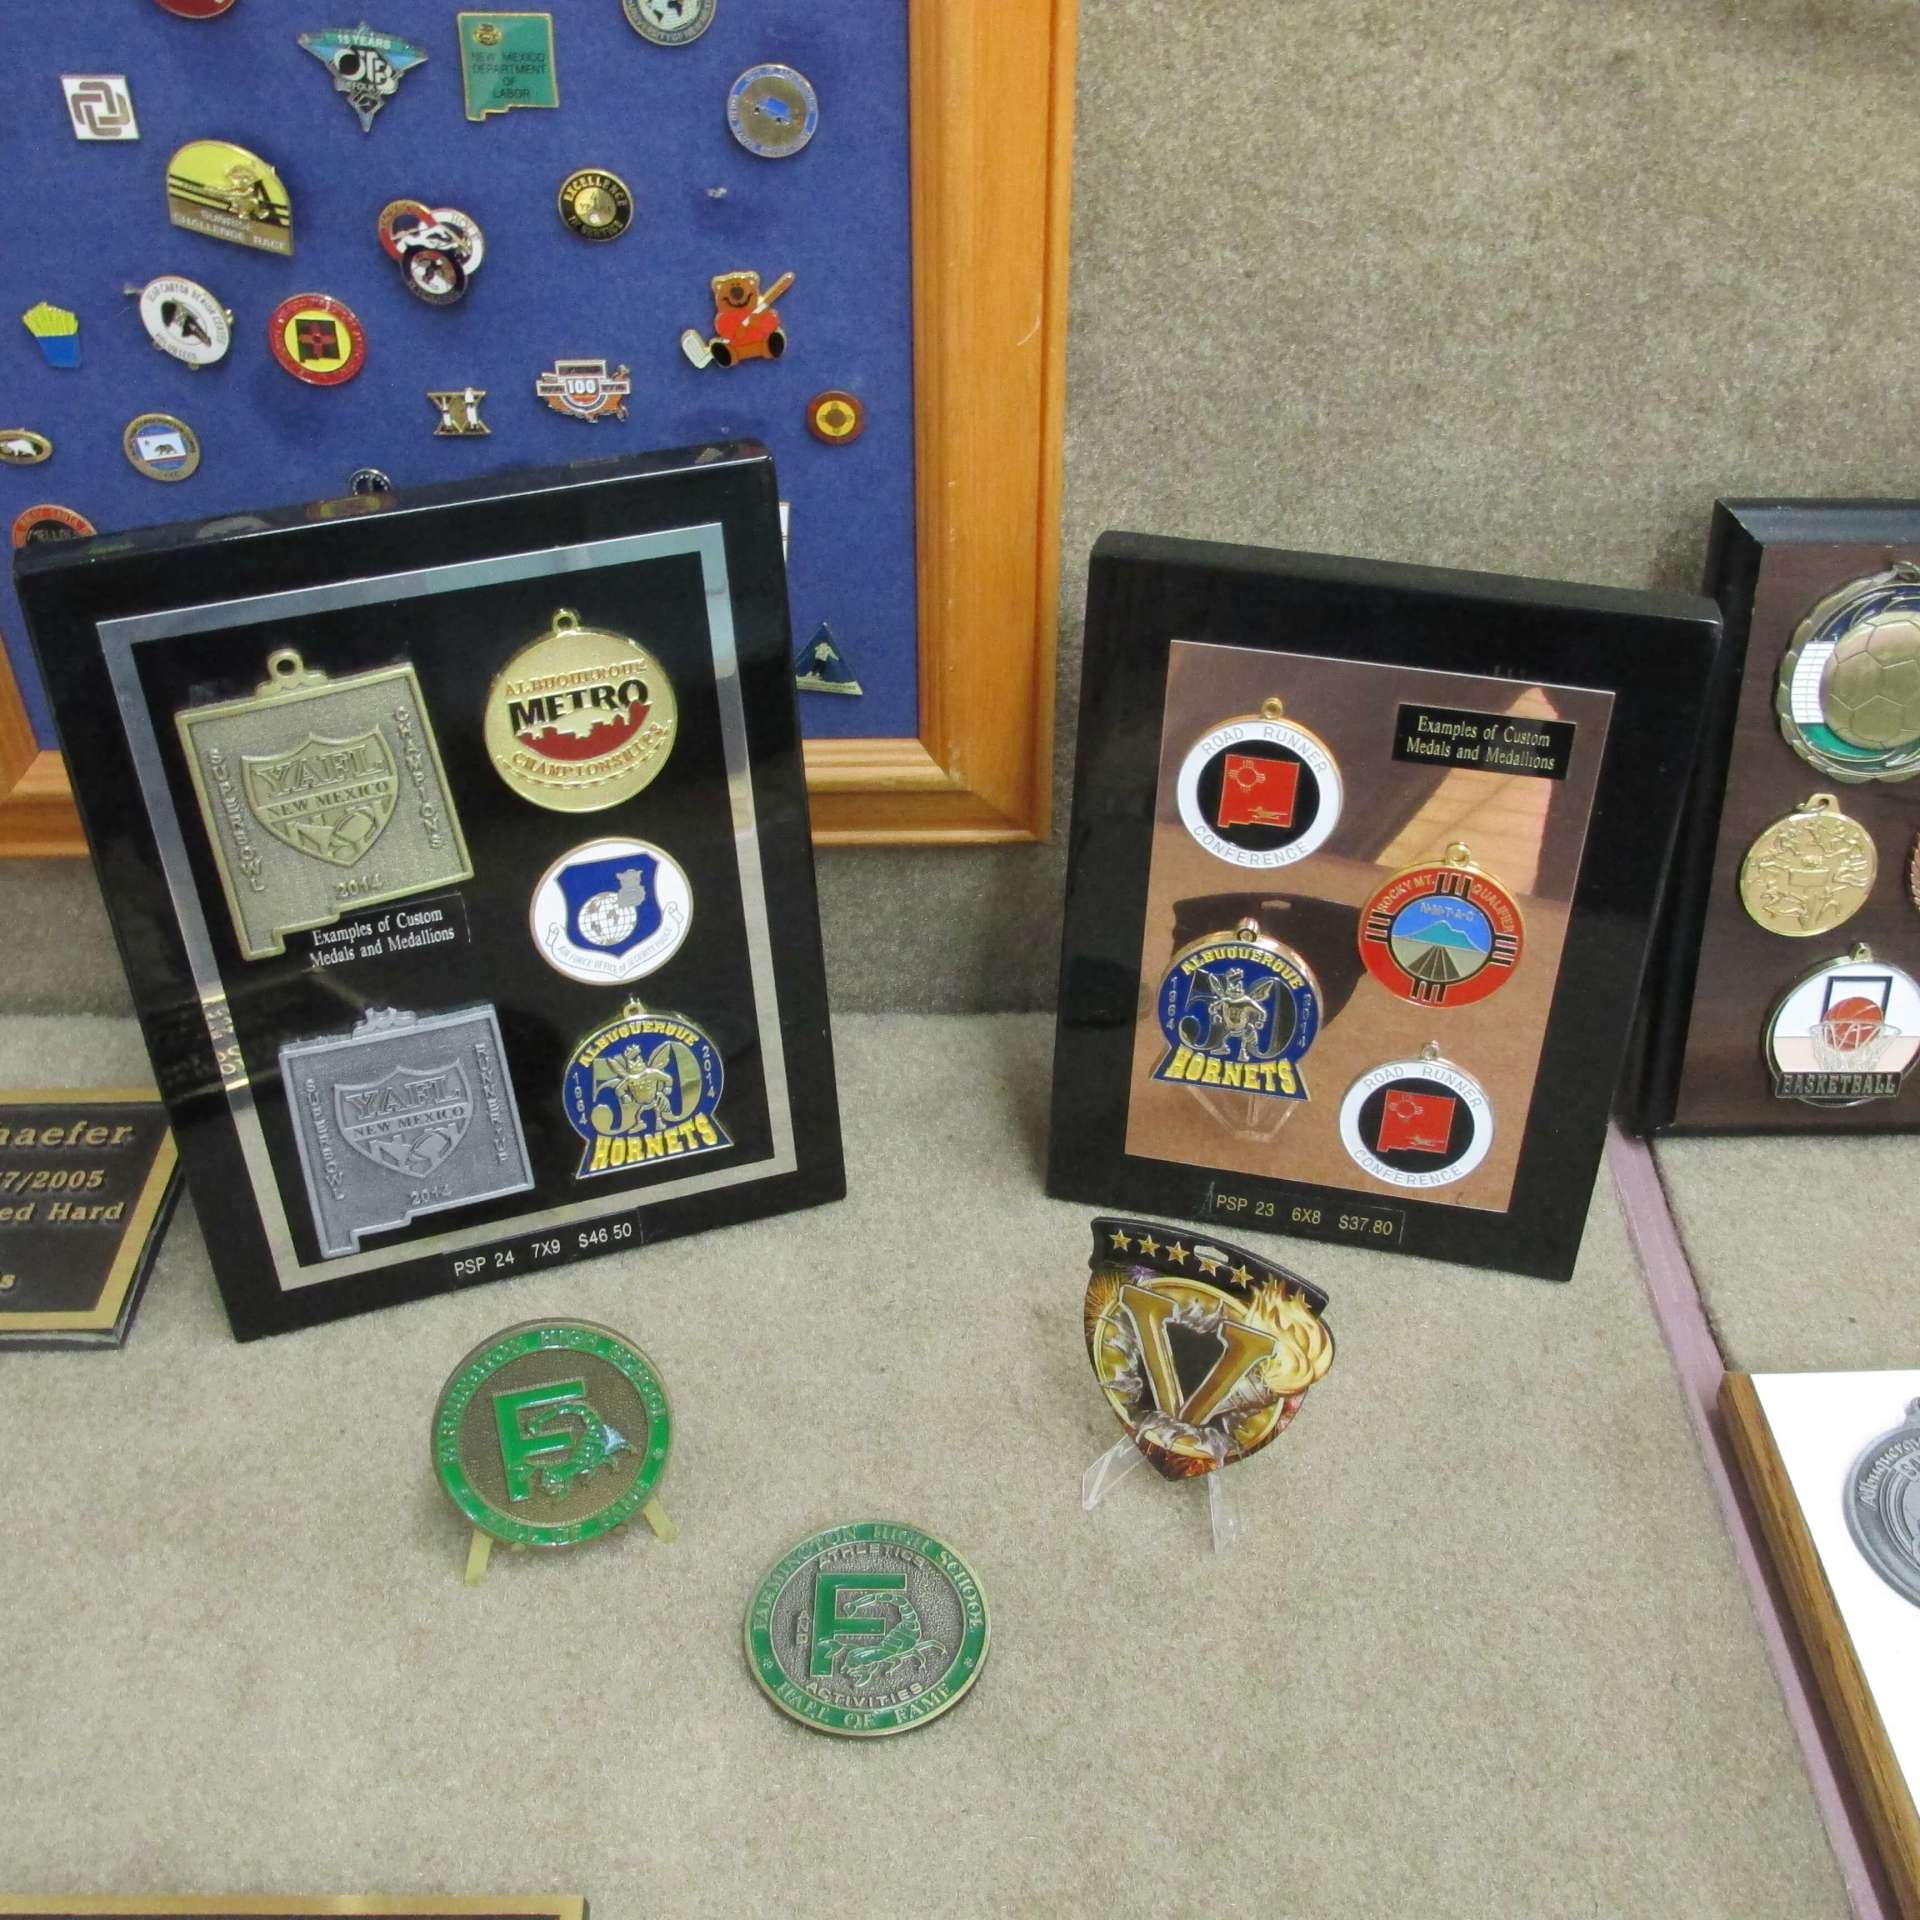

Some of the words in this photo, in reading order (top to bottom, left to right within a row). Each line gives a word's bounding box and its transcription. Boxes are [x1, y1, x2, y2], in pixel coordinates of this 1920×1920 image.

[567, 380, 596, 394] 100
[508, 679, 651, 736] METRO
[1200, 726, 1246, 757] ROAD
[1263, 726, 1329, 774] RUNNER
[1417, 715, 1477, 740] Examples
[1483, 724, 1498, 741] of
[1503, 726, 1551, 747] Custom
[1406, 736, 1452, 757] Medals
[1456, 745, 1479, 760] and
[1485, 746, 1556, 770] Medallions
[394, 706, 443, 849] CHAMPIONS
[267, 797, 309, 819] NEW
[317, 781, 390, 807] MEXICO
[1193, 823, 1309, 867] CONFERENCE
[1377, 879, 1412, 914] ROCKY
[309, 945, 356, 969] Medals
[360, 939, 383, 957] and
[388, 925, 456, 952] Medallions
[312, 921, 374, 947] Examples
[377, 914, 391, 933] of
[396, 909, 444, 929] Custom
[1180, 946, 1305, 990] ALBUQUERQUE
[578, 1019, 701, 1069] ALBUQUERQUE
[701, 1044, 717, 1098] 2014
[1163, 1045, 1298, 1096] HORNETS
[1363, 1065, 1405, 1091] ROAD
[1421, 1065, 1483, 1109] RUNNER
[1781, 1073, 1896, 1095] BASKETBALL
[353, 1121, 391, 1137] NEW
[399, 1106, 465, 1128] MEXICO
[588, 1111, 720, 1173] HORNETS
[0, 1169, 105, 1192] 7/2005
[1353, 1149, 1463, 1187] CONFERENCE
[48, 1201, 125, 1222] Hard
[1216, 1194, 1248, 1213] PSP
[1255, 1201, 1275, 1217] 23
[1291, 1207, 1321, 1225] 6X8
[454, 1256, 487, 1277] PSP
[494, 1250, 515, 1268] 24
[531, 1239, 561, 1259] 7X9
[818, 1541, 926, 1569] ATHLETICS
[753, 1524, 858, 1632] FARMINGTON
[936, 1549, 986, 1629] SCHOOL
[805, 1680, 925, 1708] ACTIVITIES
[844, 1711, 877, 1730] OF
[892, 1681, 955, 1725] FAME
